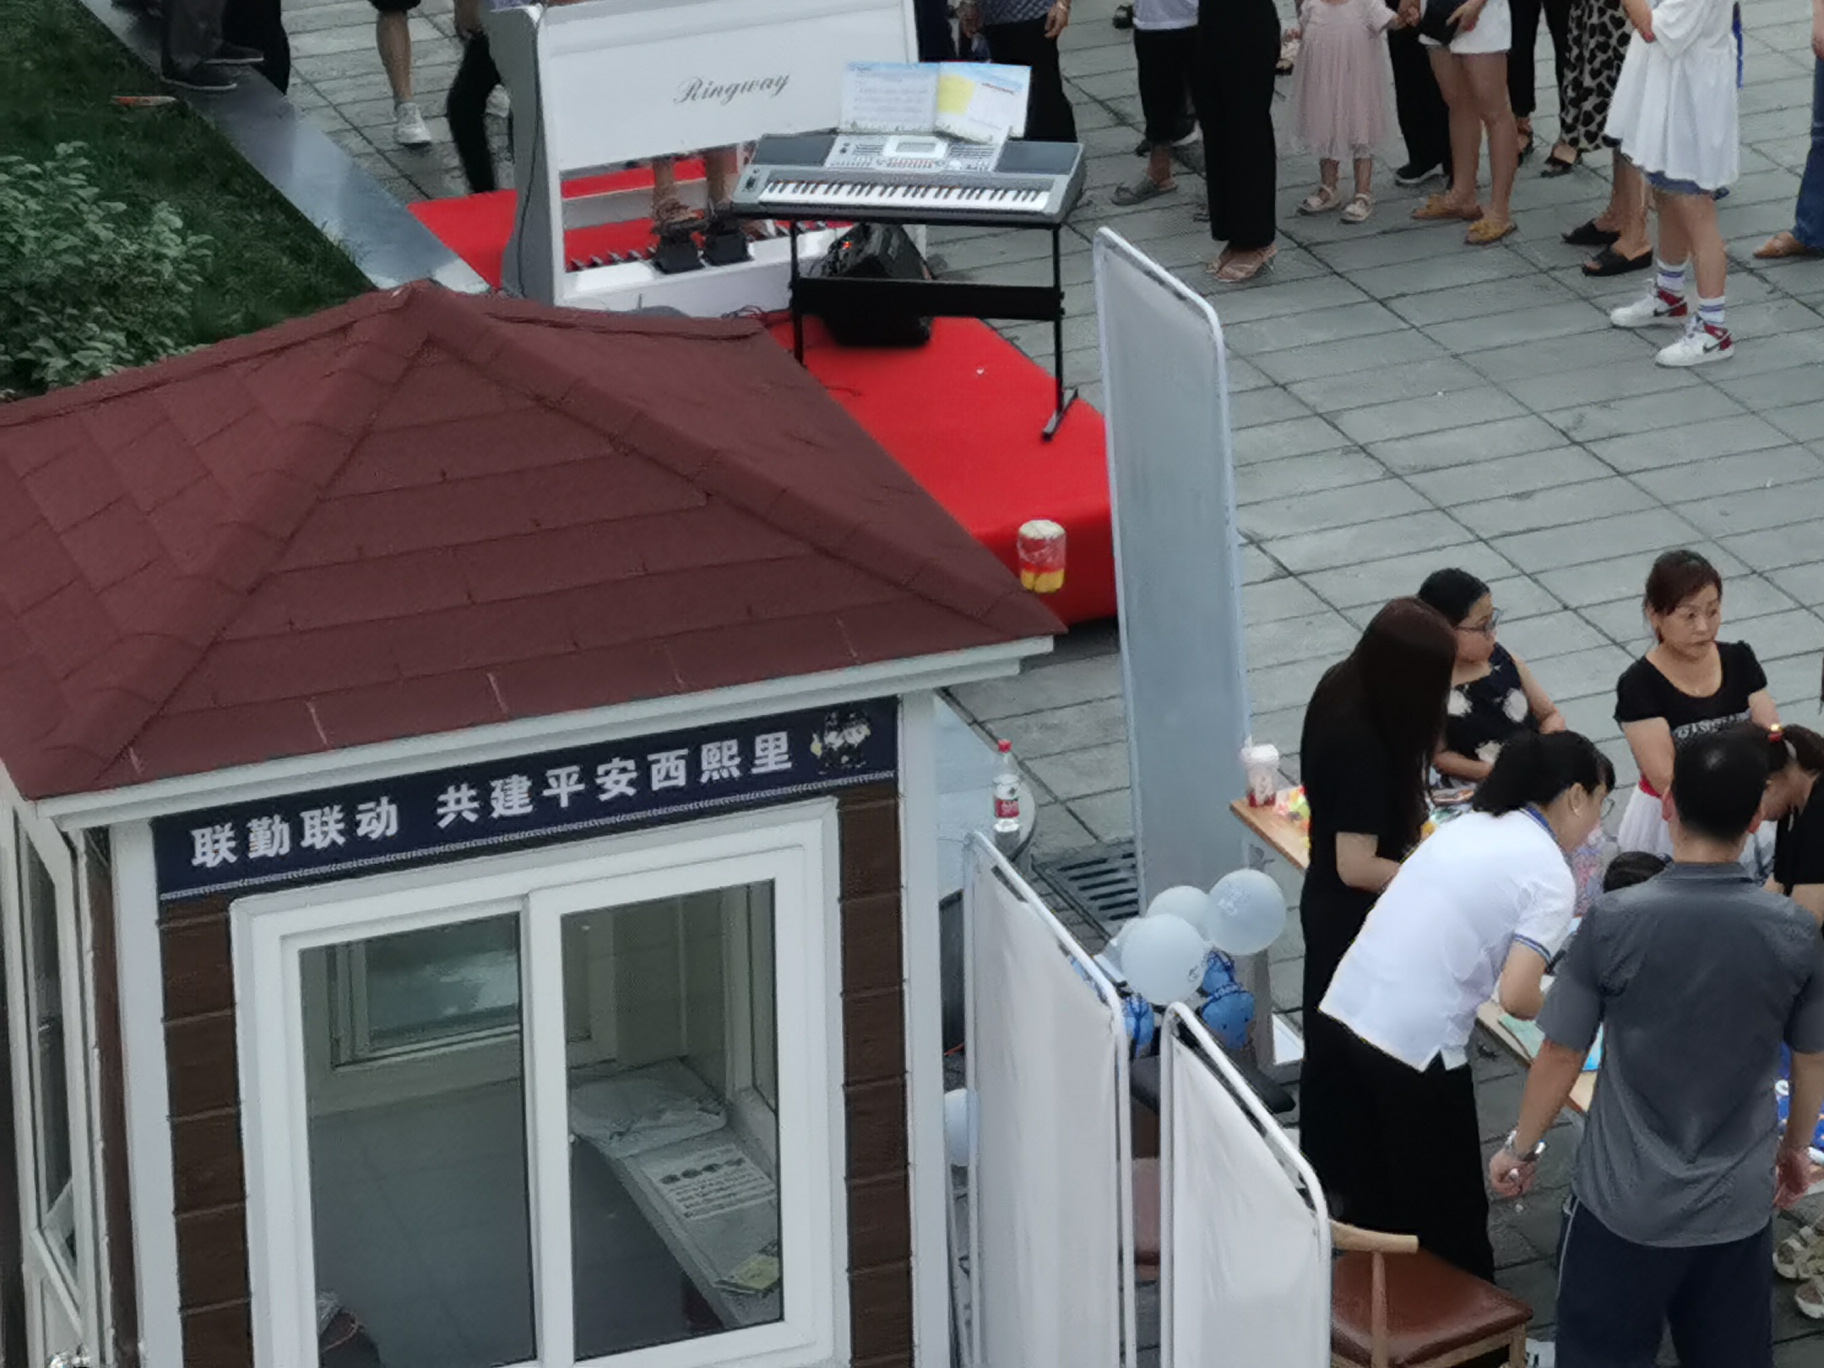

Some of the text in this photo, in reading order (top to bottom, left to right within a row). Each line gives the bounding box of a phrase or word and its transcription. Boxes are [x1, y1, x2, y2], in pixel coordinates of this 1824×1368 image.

[673, 74, 790, 107] Ringway
[191, 731, 793, 868] 联勤联动 共建平安西熙里
